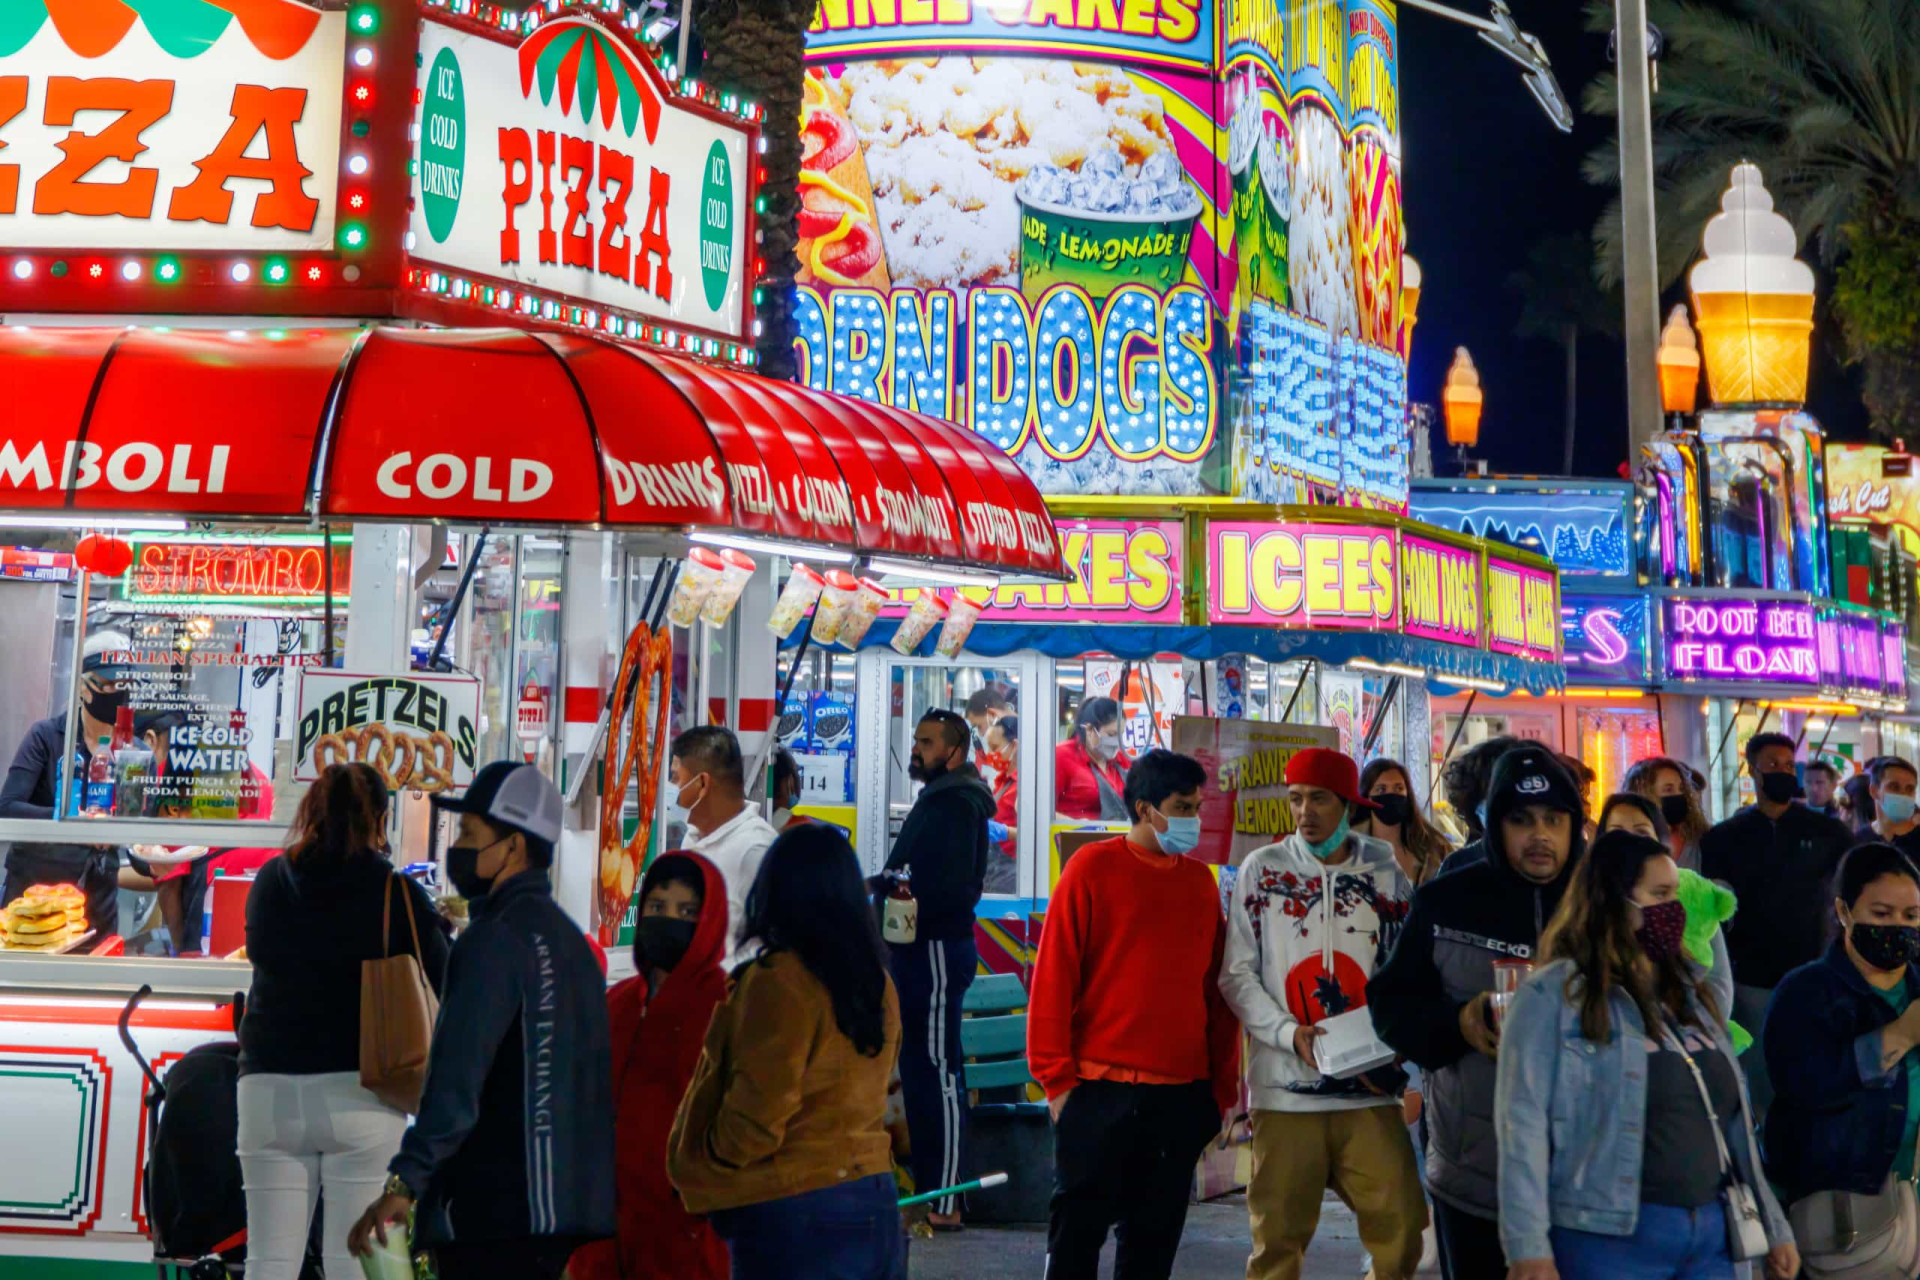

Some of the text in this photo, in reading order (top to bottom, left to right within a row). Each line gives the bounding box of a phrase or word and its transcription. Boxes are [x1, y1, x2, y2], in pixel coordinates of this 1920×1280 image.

[438, 65, 455, 101] ICE
[1350, 43, 1396, 138] CORN DOGS
[431, 113, 457, 151] COLD
[0, 74, 319, 232] ZA
[711, 154, 726, 188] ICE
[423, 167, 460, 202] DRINKS
[499, 126, 675, 302] PIZZA
[707, 193, 728, 232] COLD
[702, 239, 731, 274] DRINKS
[1060, 231, 1174, 271] LEMONADE
[967, 283, 1219, 463] DOGS
[376, 450, 554, 502] COLD
[605, 455, 725, 507] DRINKS
[726, 461, 775, 515] PIZZA
[1855, 479, 1890, 514] Cut
[138, 544, 322, 596] STROMBO
[1218, 531, 1395, 619] ICEES
[1402, 540, 1479, 638] CORN DOGS
[1524, 572, 1560, 655] CAKES
[1674, 603, 1758, 636] ROOT
[101, 650, 186, 665] ITALIAN
[115, 671, 197, 682] STROMBOLI
[1672, 643, 1818, 677] FLOATS
[114, 682, 178, 692] CALZONE
[187, 713, 223, 722] EXTRA
[297, 677, 477, 770] PRETZELS
[815, 706, 849, 717] OREO
[168, 749, 250, 771] WATER
[132, 776, 173, 786] FRUIT
[176, 776, 224, 787] PUNCH
[142, 787, 263, 799] SODA LEMONADE
[532, 932, 556, 1137] ARMANI EXCHANGE
